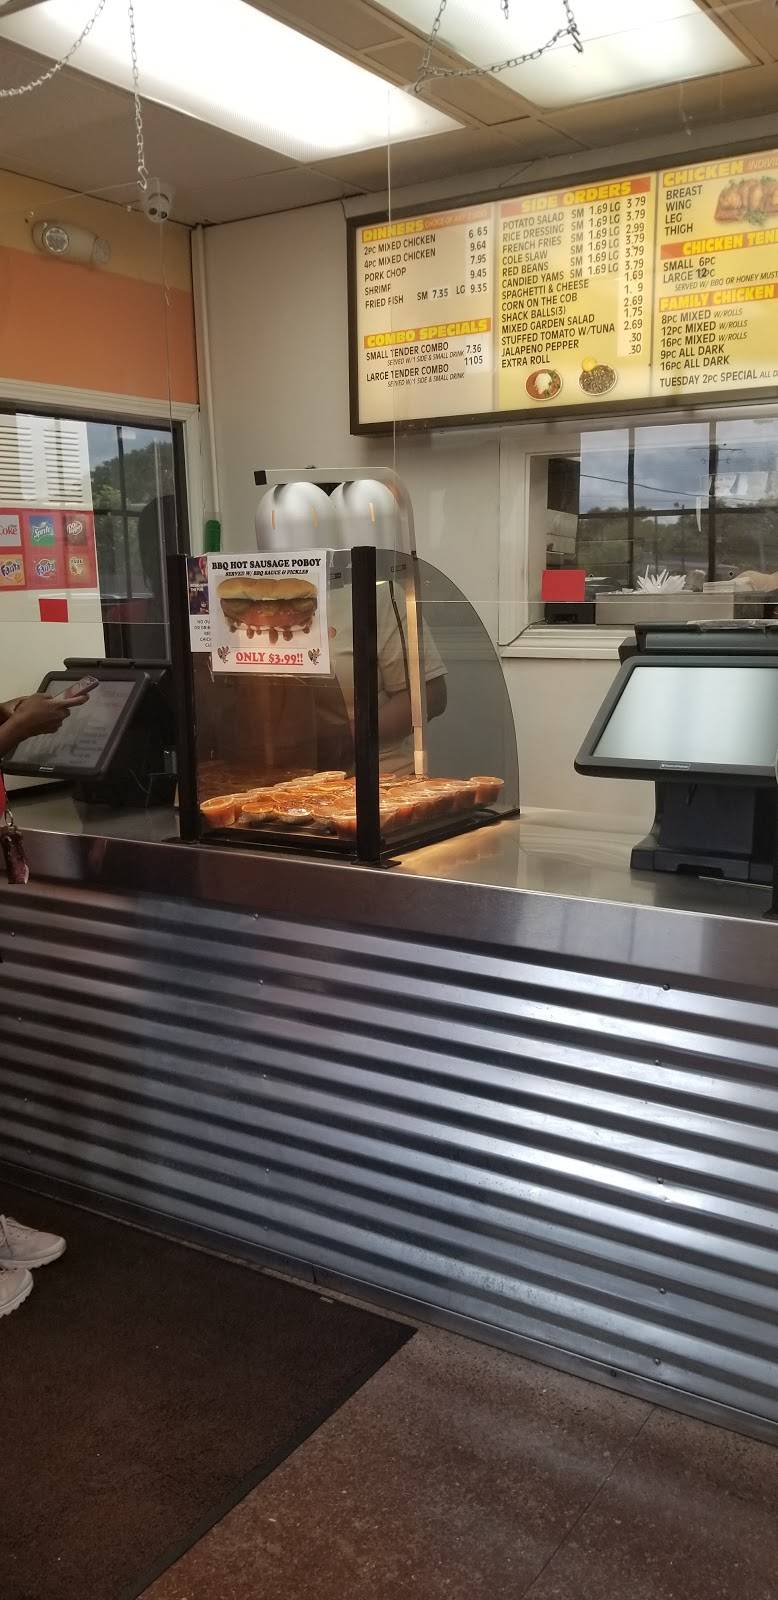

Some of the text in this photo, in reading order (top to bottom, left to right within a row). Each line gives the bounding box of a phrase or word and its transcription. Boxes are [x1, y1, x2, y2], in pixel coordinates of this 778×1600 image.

[663, 160, 743, 187] CHICKEN
[521, 182, 631, 213] SIDE ORDERS
[666, 185, 702, 199] BREAST
[503, 202, 620, 230] POTATO SALAD SM 1.69 LG
[666, 199, 692, 212] WING
[503, 209, 645, 242] RICE DRESSING SM 1.69 LG 3.79
[664, 223, 693, 236] THIGH
[665, 213, 682, 224] LEG
[363, 220, 425, 241] DINNERS
[503, 223, 644, 254] FRENCH FRIES SM 1.69 LG 2.99
[364, 234, 436, 255] 2PC MIXED CHICKEN
[364, 240, 486, 269] 4PC MIXED CHICKEN 9.64
[503, 233, 644, 265] COLE SLAW SM 1.69 LG 3.79
[683, 234, 743, 256] CHICKEN
[365, 254, 486, 282] PORK CHOP 7.95
[503, 246, 644, 277] RED BEANS SM 1.69 LG 3.79
[664, 256, 715, 272] SMALL 6PC
[365, 268, 487, 296] SHRIMP 9.45
[502, 259, 644, 288] CANDIED YAMS SM 1.69 LG 3.79
[502, 270, 644, 299] SPAGHETTI & CHEESE 1.69
[664, 270, 693, 284] LARGE
[675, 281, 698, 291] SERVED
[736, 273, 759, 283] HONEY
[760, 271, 778, 280] MUST
[365, 282, 487, 309] FRIED FISH SM 7.35 LG 9.35
[502, 293, 578, 311] CORN ON THE COB
[659, 284, 774, 312] FAMILY CHICKEN
[502, 295, 643, 322] SHACK BALLS(3) 2.69
[661, 314, 678, 324] 8PC
[680, 309, 711, 322] MIXED
[502, 307, 643, 334] MIXED GARDEN SALAD 1.75
[661, 320, 748, 336] 12PC MIXED W/ROLLS
[367, 320, 488, 347] COMBO SPECIALS
[502, 319, 643, 345] STUFFED TOMATO W/TUNA 2.69
[661, 332, 747, 348] 16PC MIXED W/ROLLS
[366, 342, 482, 361] SMALL TENDER COMBO 7.36
[501, 332, 642, 357] JALAPENO PEPPER .30
[661, 344, 724, 360] 9PC ALL DARK
[502, 345, 641, 369] EXTRA ROLL .30
[660, 355, 730, 371] 16PC ALL DARK
[366, 370, 389, 382] LARGE
[391, 367, 419, 378] TENDER
[422, 364, 448, 375] COMBO
[660, 375, 699, 387] TUESDAY
[703, 374, 717, 384] 2PC
[721, 370, 757, 382] SPECIAL
[212, 559, 321, 570] BBQ HOT SAUSAGE POBOY
[236, 652, 303, 664] ONLY $3.99!!
